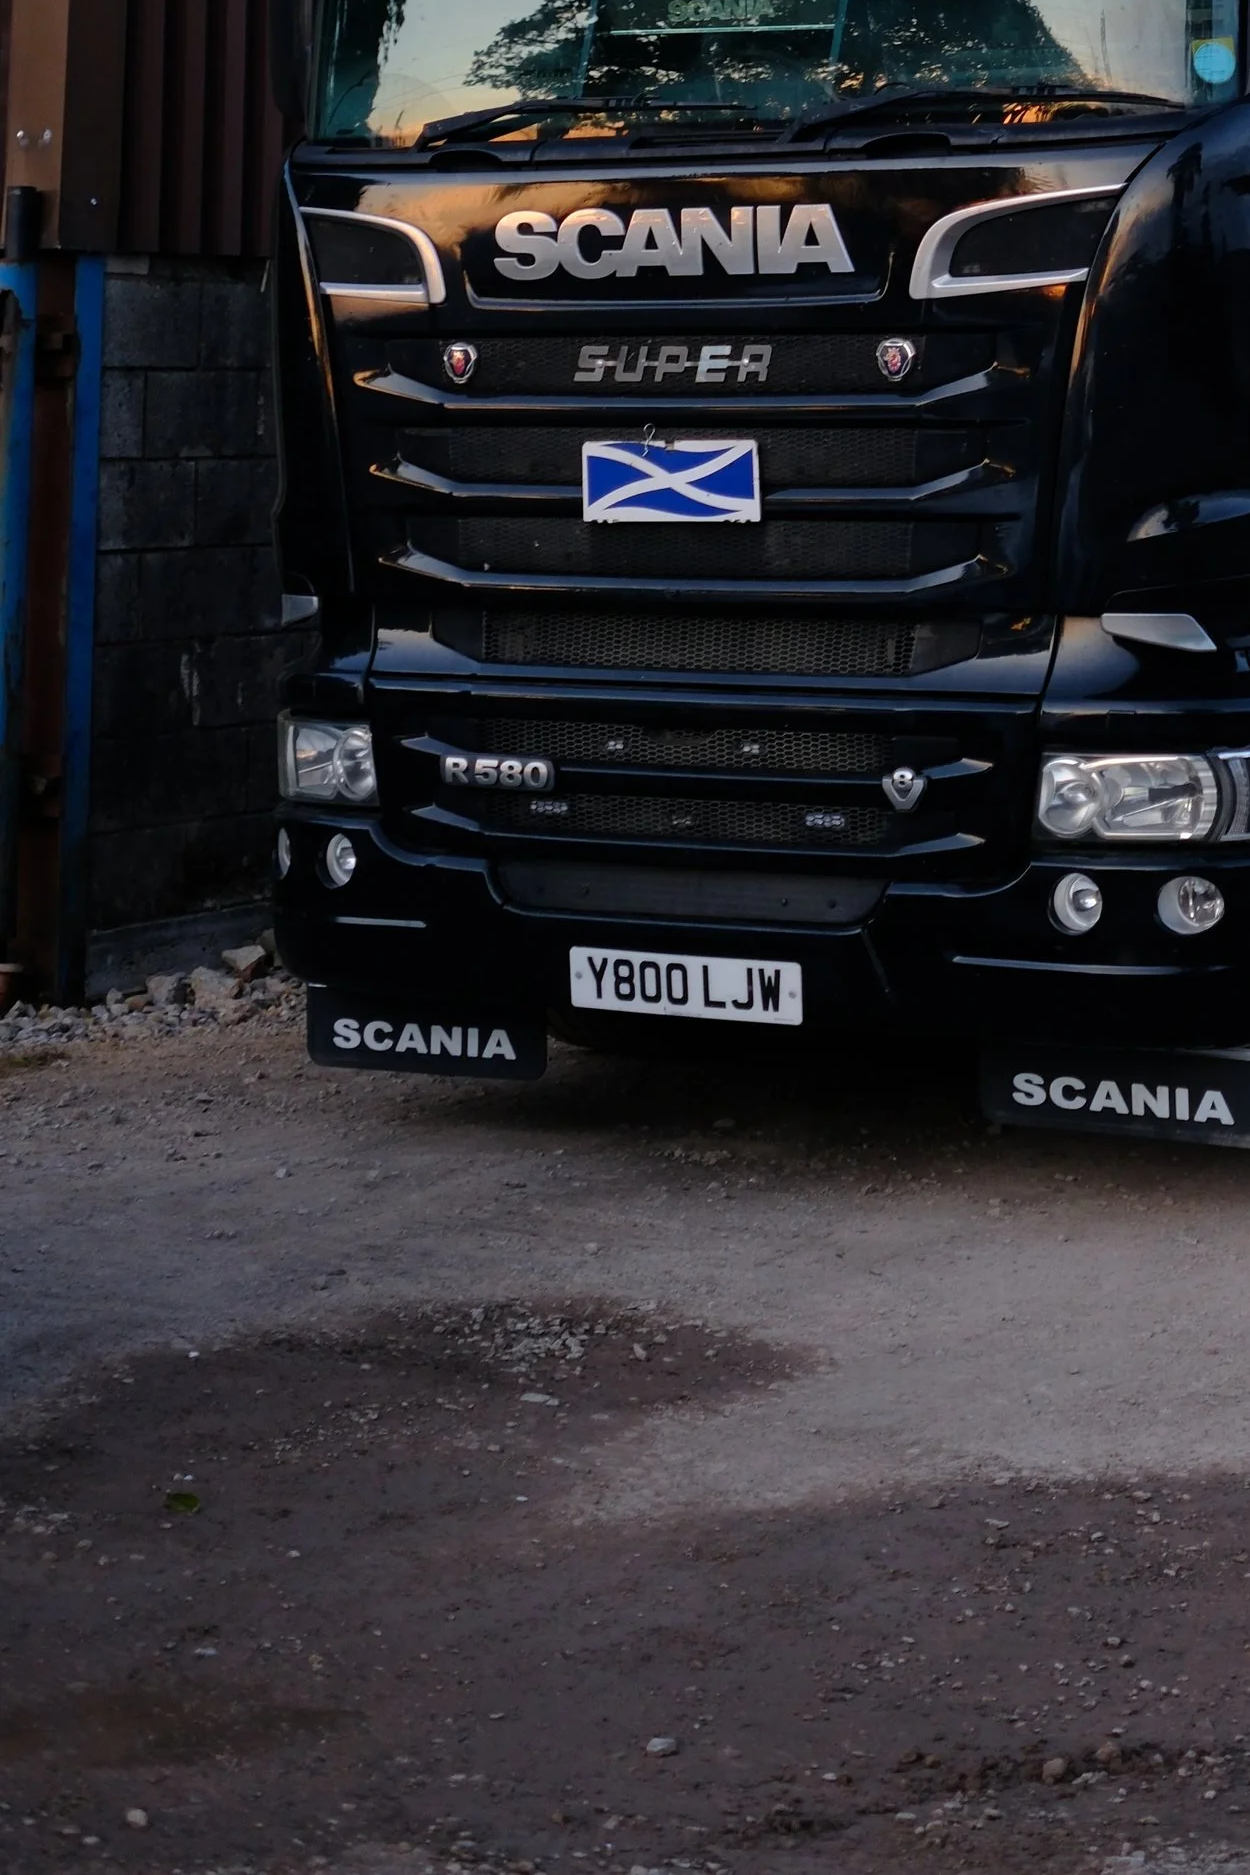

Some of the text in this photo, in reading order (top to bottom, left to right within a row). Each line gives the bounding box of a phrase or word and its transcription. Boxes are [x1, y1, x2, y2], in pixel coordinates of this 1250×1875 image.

[493, 203, 855, 280] SCANIA
[573, 344, 773, 383] SUPER
[588, 956, 781, 1013] Y800 LJW
[332, 1018, 516, 1062] SCANIA
[1012, 1073, 1235, 1126] SCANIA
